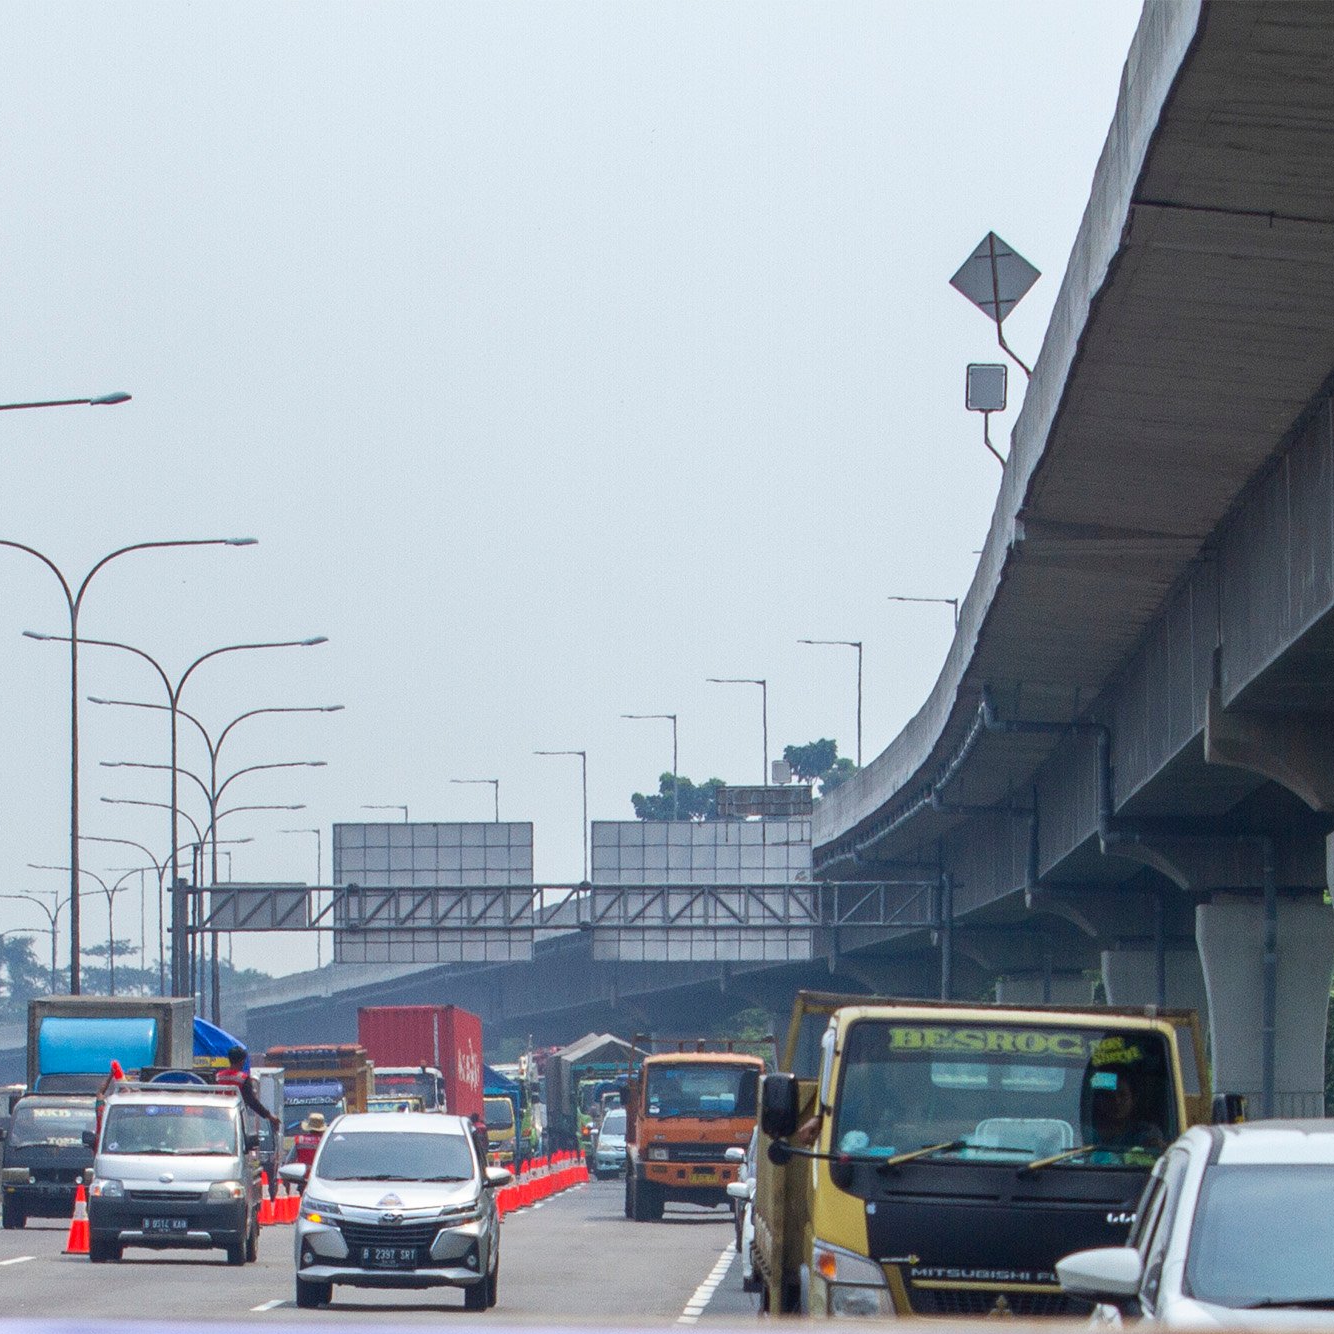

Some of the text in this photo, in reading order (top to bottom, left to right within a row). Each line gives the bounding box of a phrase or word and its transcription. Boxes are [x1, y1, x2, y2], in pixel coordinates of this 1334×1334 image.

[375, 1247, 395, 1260] 2397
[911, 1267, 1059, 1282] MITSUBISHI FU
